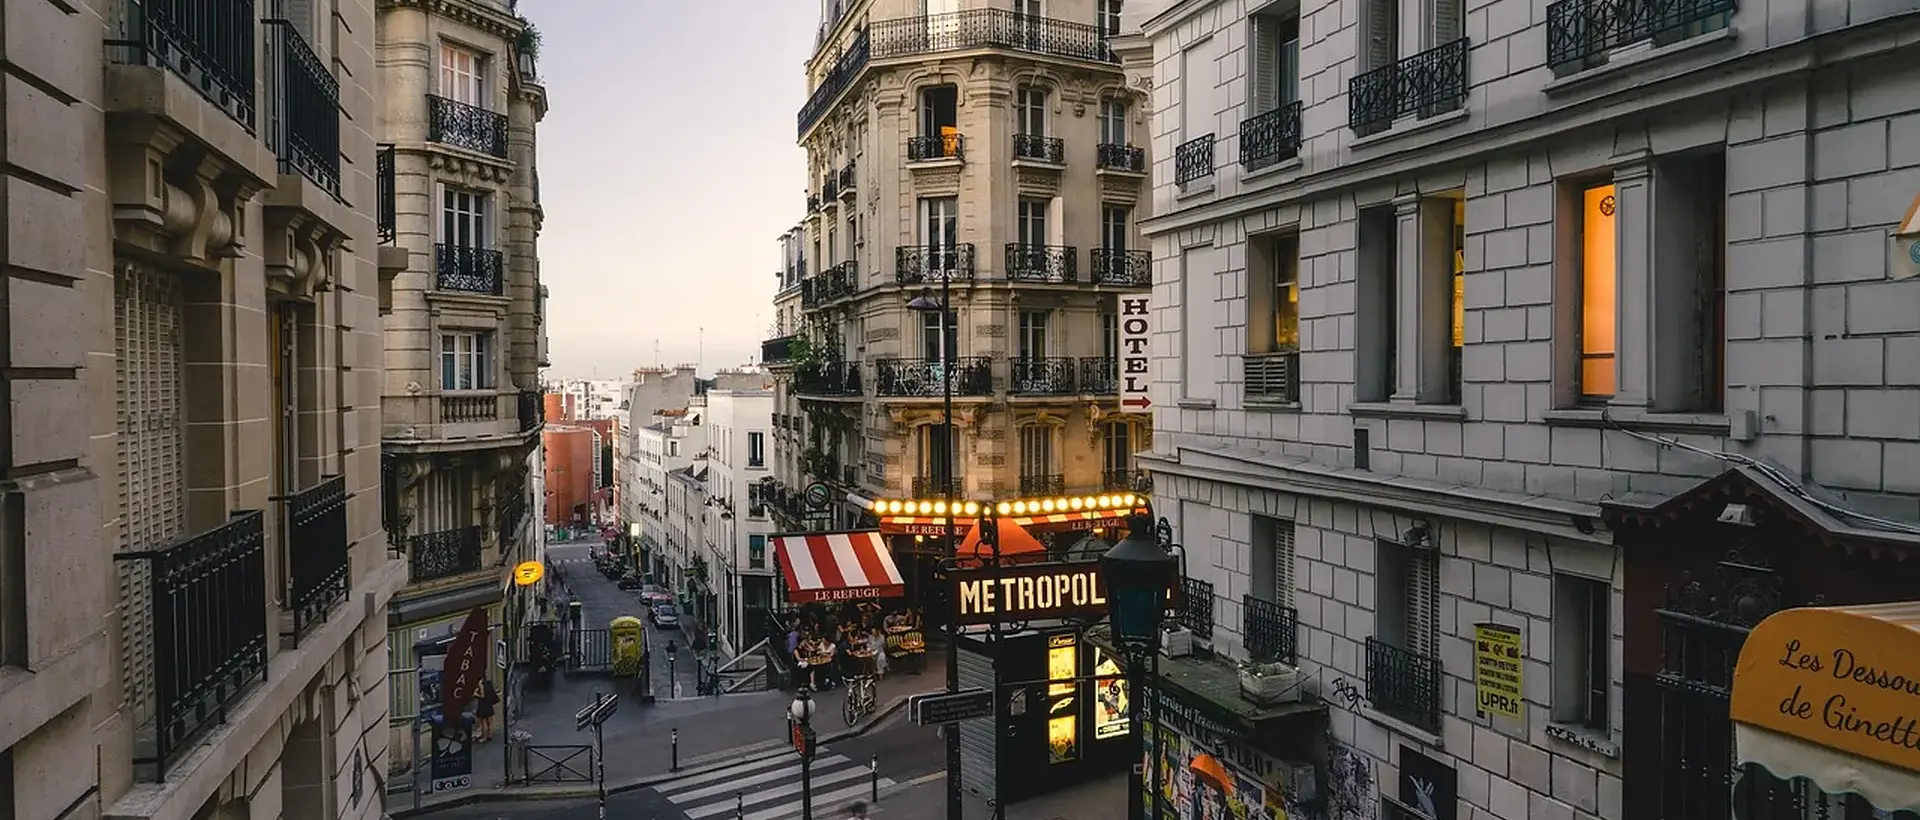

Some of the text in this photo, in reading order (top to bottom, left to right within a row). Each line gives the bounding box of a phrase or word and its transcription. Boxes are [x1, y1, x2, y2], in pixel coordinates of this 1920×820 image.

[1122, 299, 1149, 393] HOTEL
[905, 525, 964, 535] LE REFUE
[814, 588, 880, 601] LE REFUGE
[959, 572, 1171, 615] METROPOL
[453, 631, 479, 699] TABAC
[1779, 639, 1824, 672] Les
[1480, 690, 1518, 715] UPR.fr
[1779, 685, 1813, 719] de
